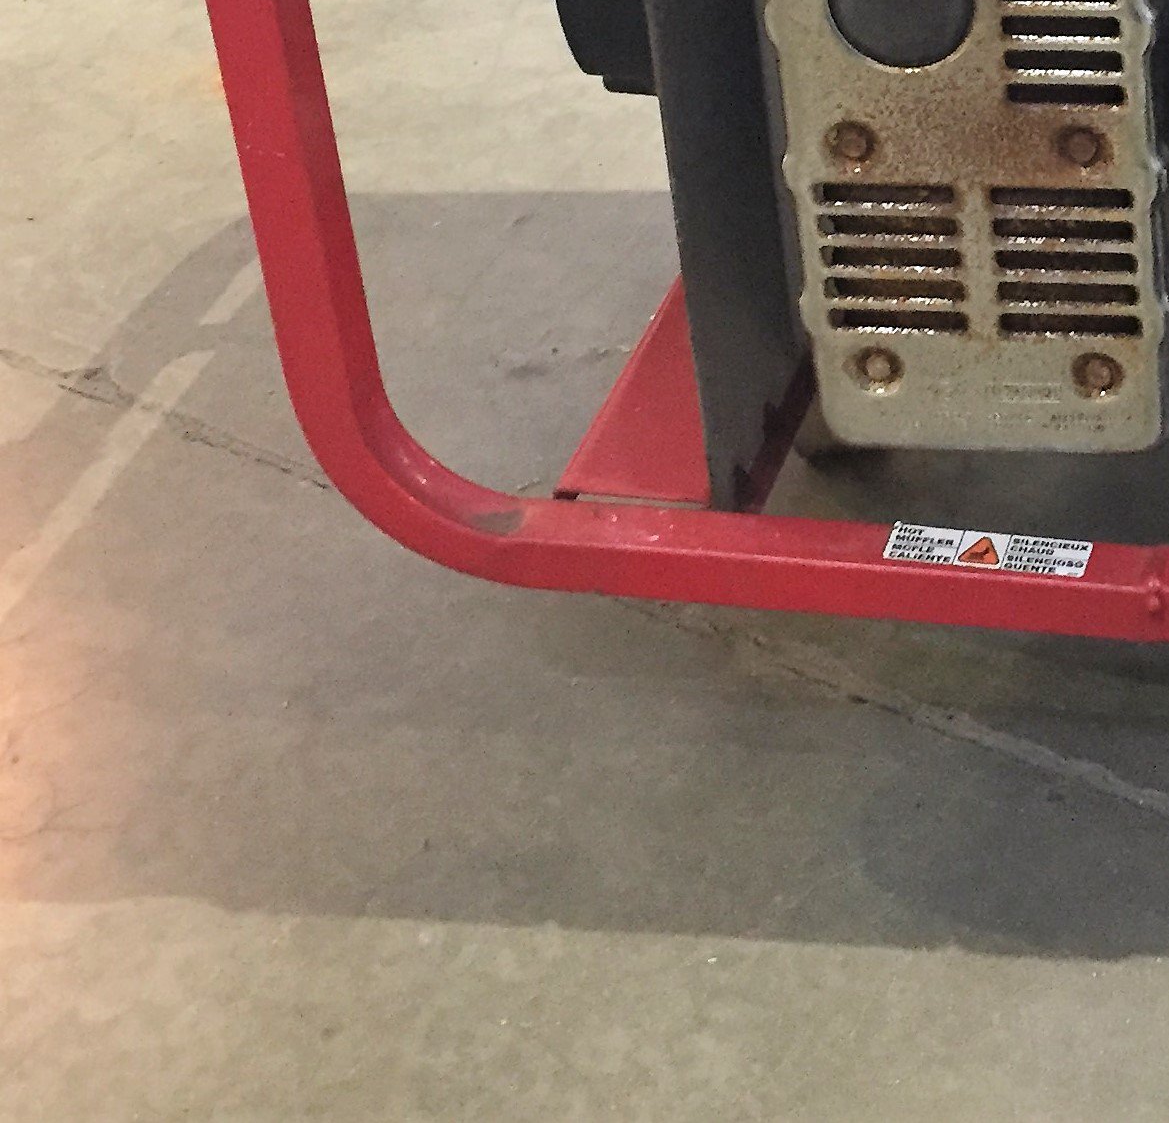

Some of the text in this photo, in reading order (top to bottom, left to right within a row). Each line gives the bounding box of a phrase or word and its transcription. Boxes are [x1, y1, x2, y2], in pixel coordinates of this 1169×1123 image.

[897, 526, 925, 536] HOT
[895, 534, 954, 546] MUFFLER
[1013, 538, 1089, 551] SILENCIEUX
[1010, 545, 1055, 555] CHAUD
[889, 551, 951, 562] CALIENTE
[1007, 554, 1084, 568] SILENCIOSO
[1004, 562, 1056, 574] QUENTE
